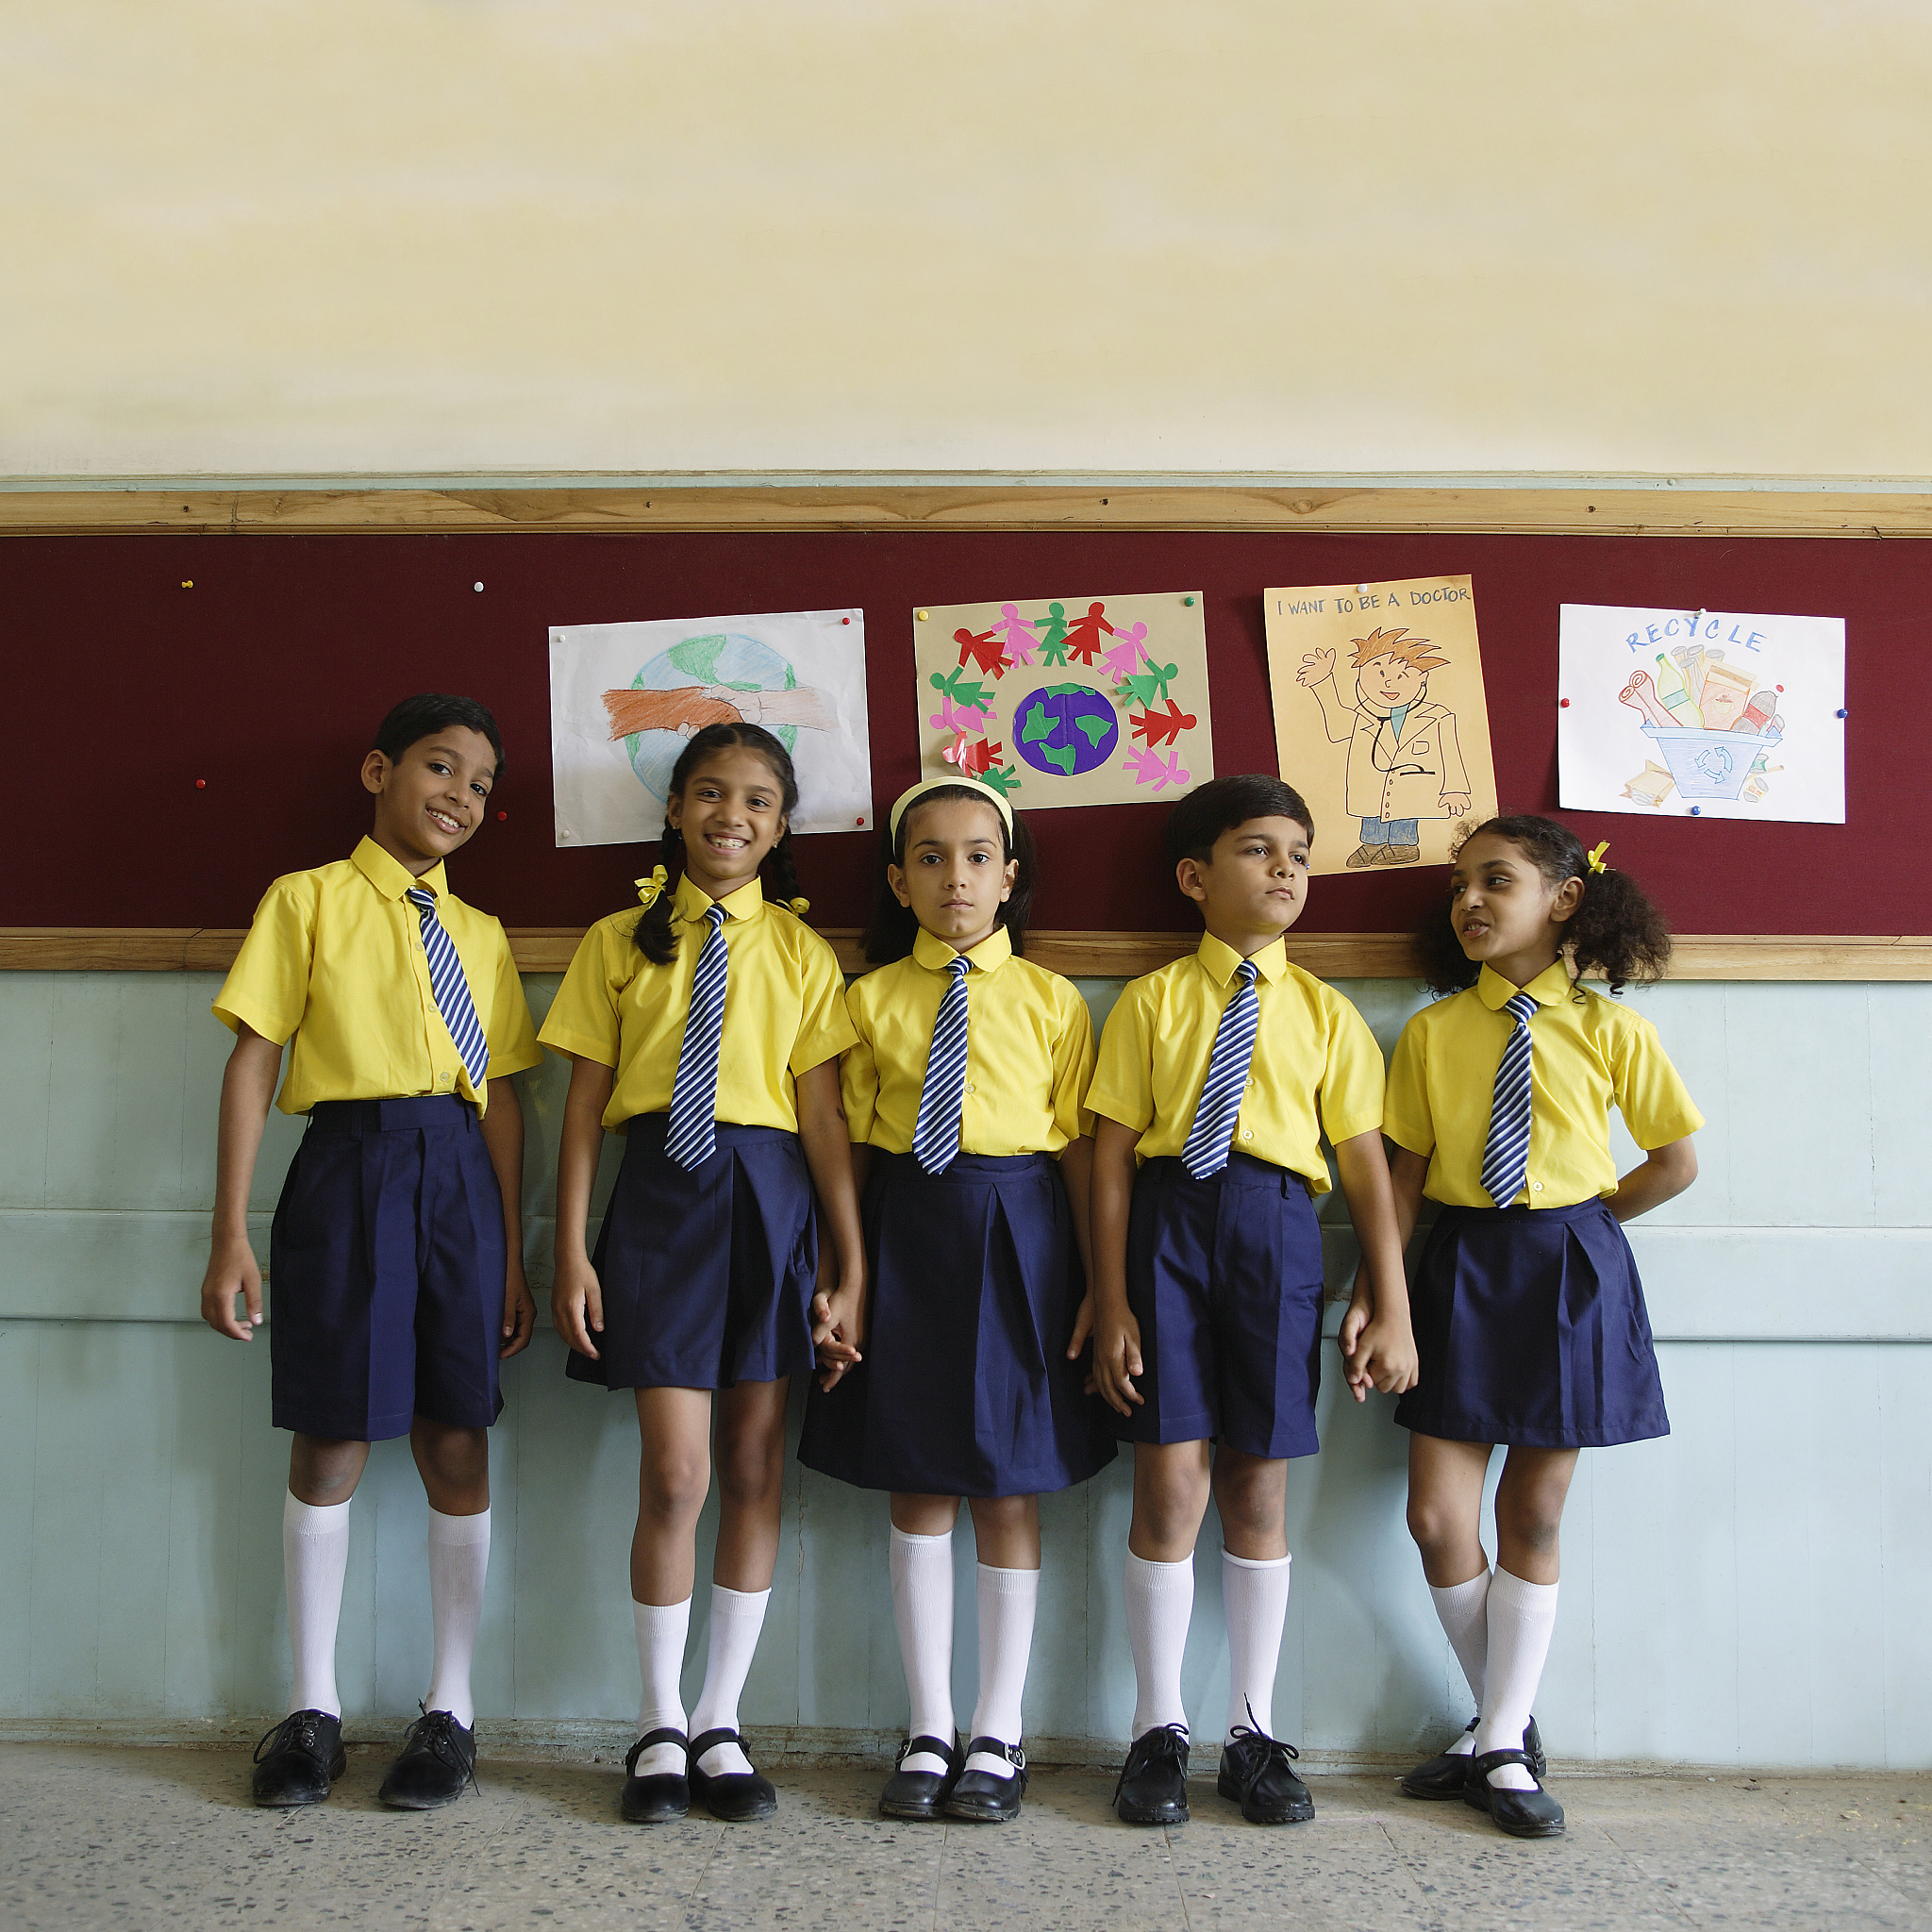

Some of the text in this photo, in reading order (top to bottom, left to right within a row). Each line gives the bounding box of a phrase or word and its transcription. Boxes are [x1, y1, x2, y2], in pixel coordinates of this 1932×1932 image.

[1277, 587, 1471, 615] I WANT TO BE A DOCTOR
[1625, 616, 1767, 654] RECYCLE
